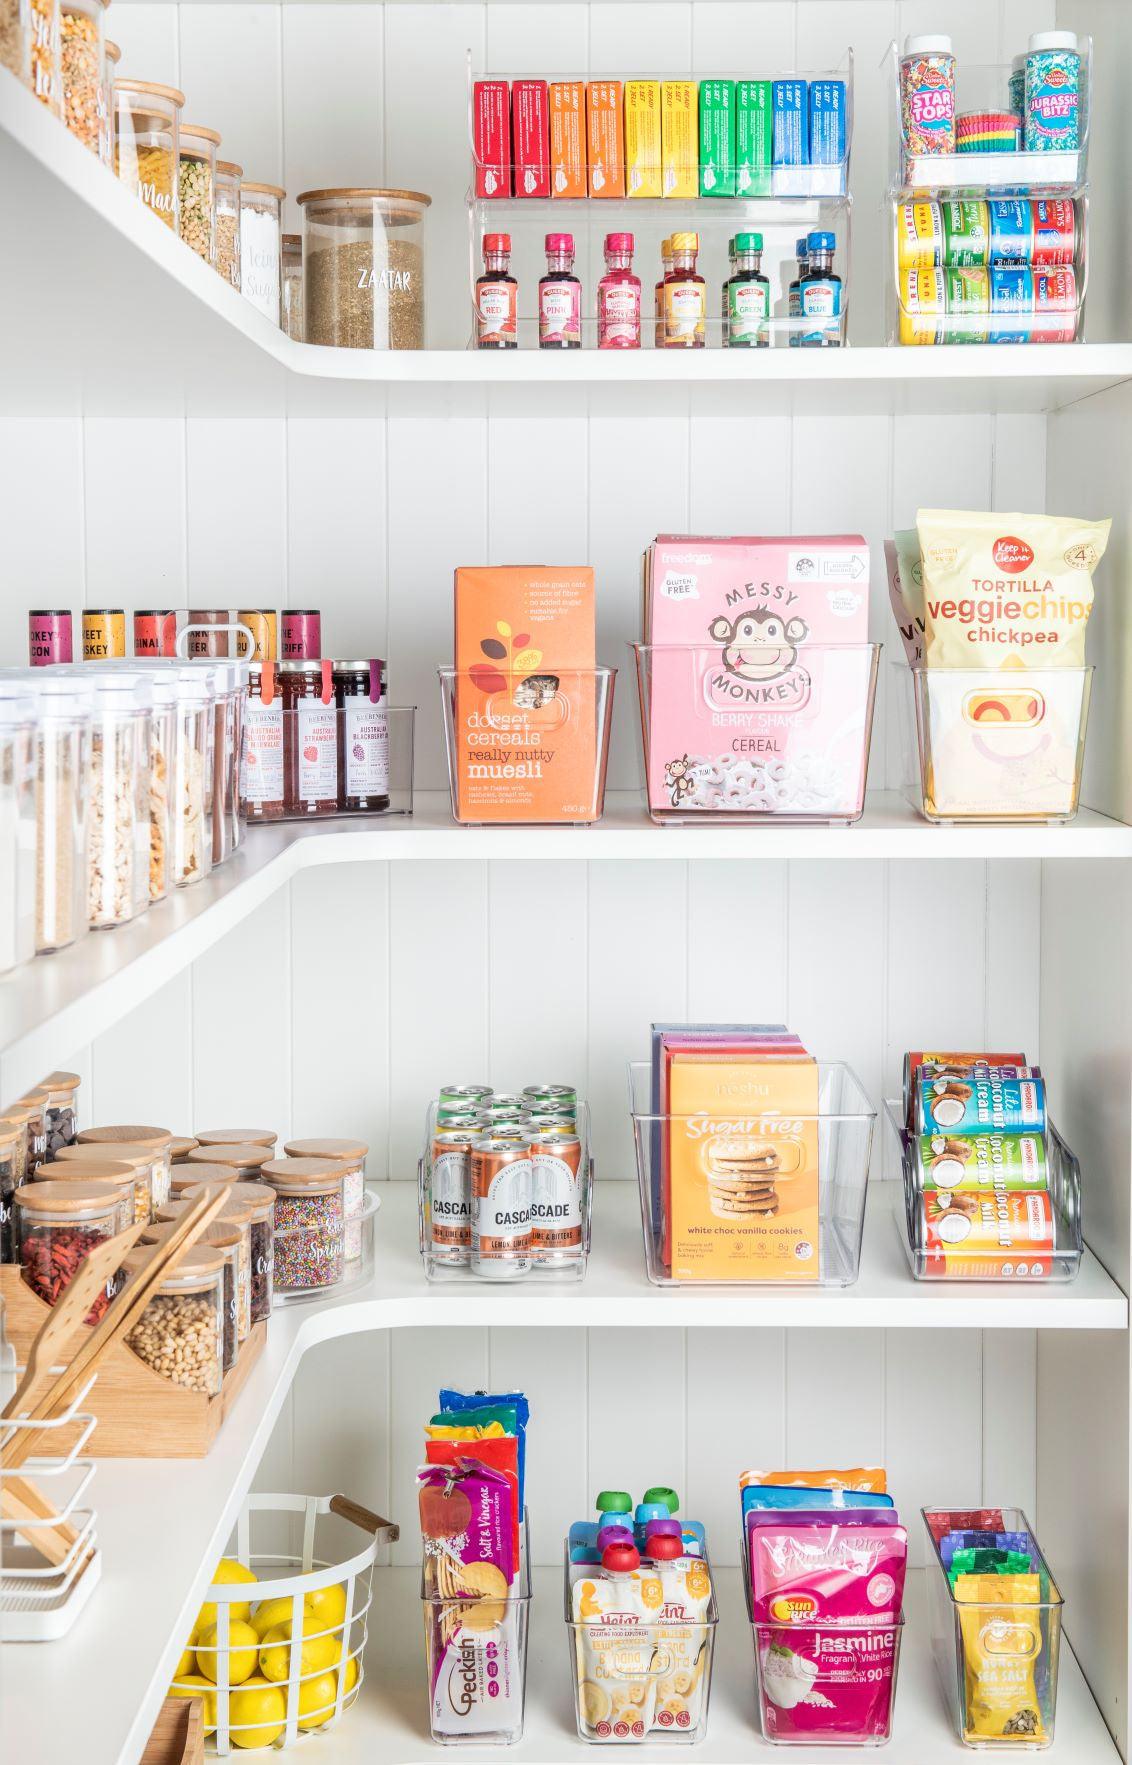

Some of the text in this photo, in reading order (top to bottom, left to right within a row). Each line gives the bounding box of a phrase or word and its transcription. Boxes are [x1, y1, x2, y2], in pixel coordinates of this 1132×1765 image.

[913, 90, 951, 109] STAR
[1030, 94, 1078, 112] JURASSIC
[913, 105, 952, 122] TOPS
[1042, 105, 1070, 117] BITZ
[357, 267, 412, 292] ZAATAR
[485, 306, 502, 314] RED
[546, 306, 566, 315] PINK
[739, 306, 763, 314] GREEN
[997, 542, 1018, 553] Keep
[1074, 550, 1086, 561] 4
[995, 552, 1031, 563] Cleaner
[667, 584, 691, 595] FREE
[724, 581, 800, 607] MESSY
[971, 579, 1054, 593] TORTILLA
[31, 630, 54, 642] OKEY
[967, 627, 1059, 646] chickpea
[31, 645, 50, 657] CON
[712, 713, 753, 728] BERRY
[467, 726, 541, 746] cereals
[732, 738, 782, 752] CEREAL
[467, 748, 554, 764] really nutty
[467, 761, 543, 779] muesli
[976, 1081, 991, 1122] Cream
[1003, 1088, 1019, 1110] Lite
[686, 1110, 807, 1139] Sugar Free
[974, 1138, 991, 1184] Cream
[989, 1135, 1007, 1191] Coconut
[495, 1208, 532, 1226] CASCA
[531, 1203, 570, 1218] SCADE
[981, 1201, 996, 1232] Milk
[995, 1191, 1012, 1247] Coconut
[687, 1226, 804, 1235] white choc vanilla cookies
[476, 1485, 494, 1558] Salt & Vinegar
[812, 1630, 894, 1658] Jasmine
[456, 1637, 478, 1704] Peckish
[867, 1668, 883, 1683] 90
[978, 1669, 1028, 1683] SEA SALT
